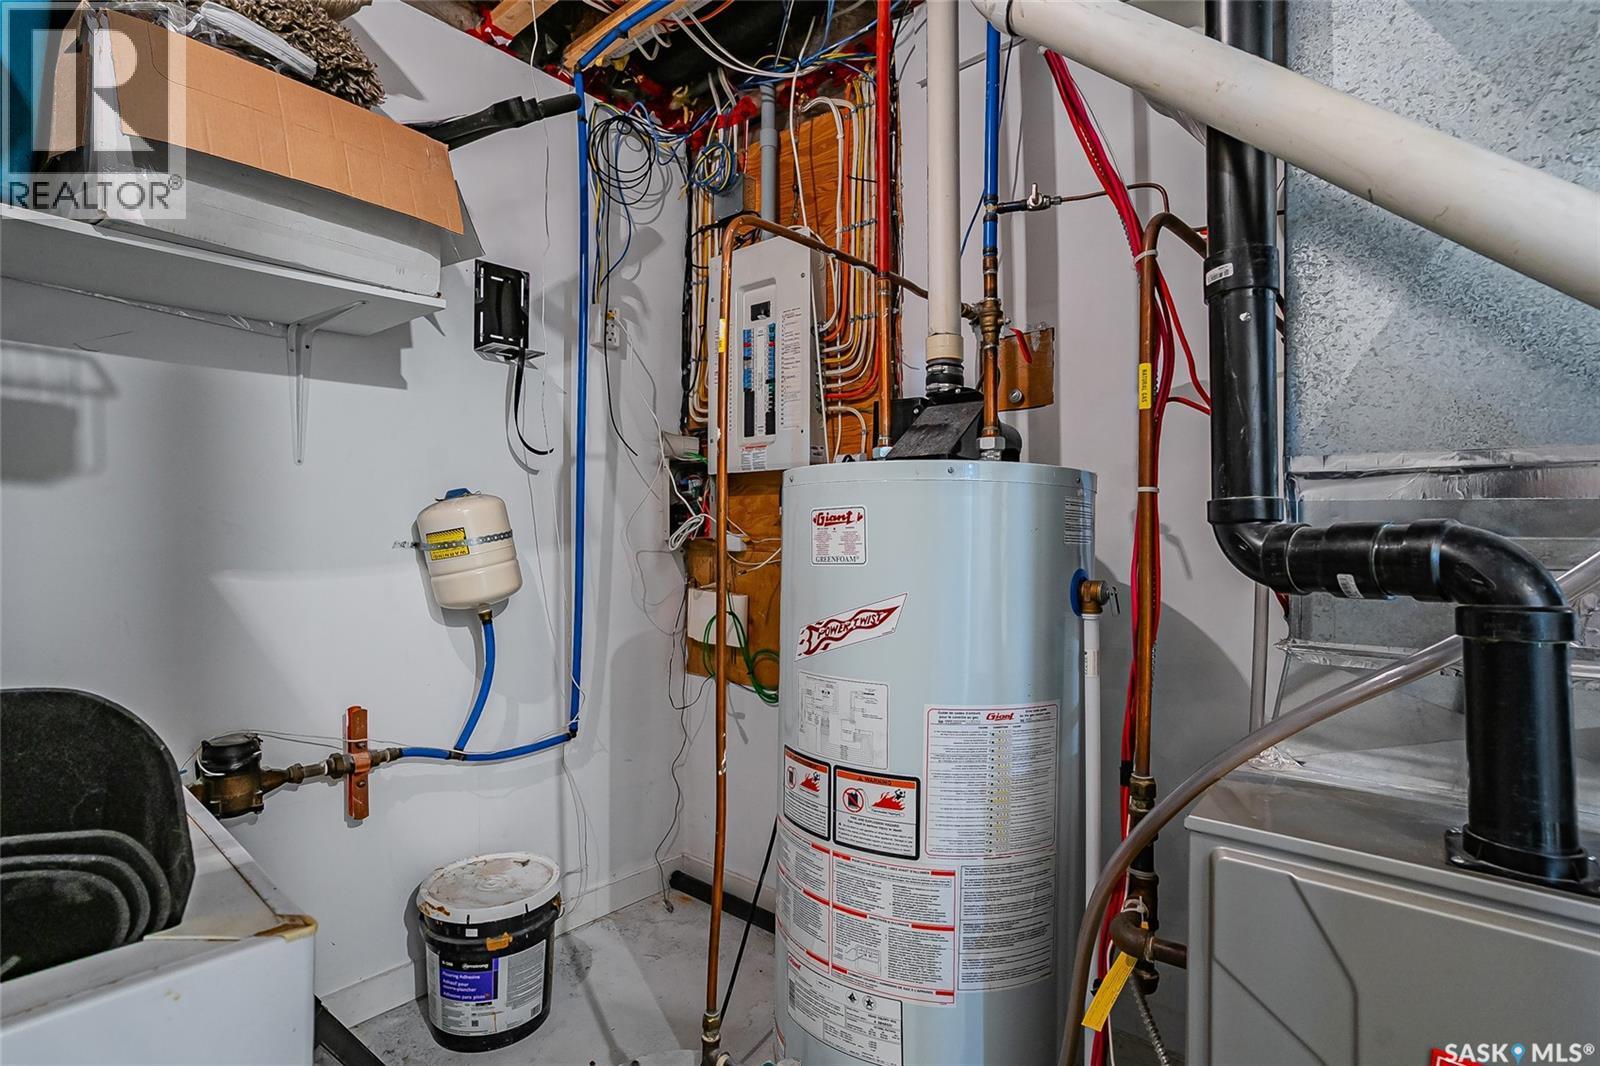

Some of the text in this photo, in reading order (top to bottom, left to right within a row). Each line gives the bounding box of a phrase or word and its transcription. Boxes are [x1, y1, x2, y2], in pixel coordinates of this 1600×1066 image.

[815, 510, 855, 527] Giant
[817, 612, 881, 640] POWER TWIST
[986, 712, 1015, 721] Giant
[864, 776, 892, 787] WARNING
